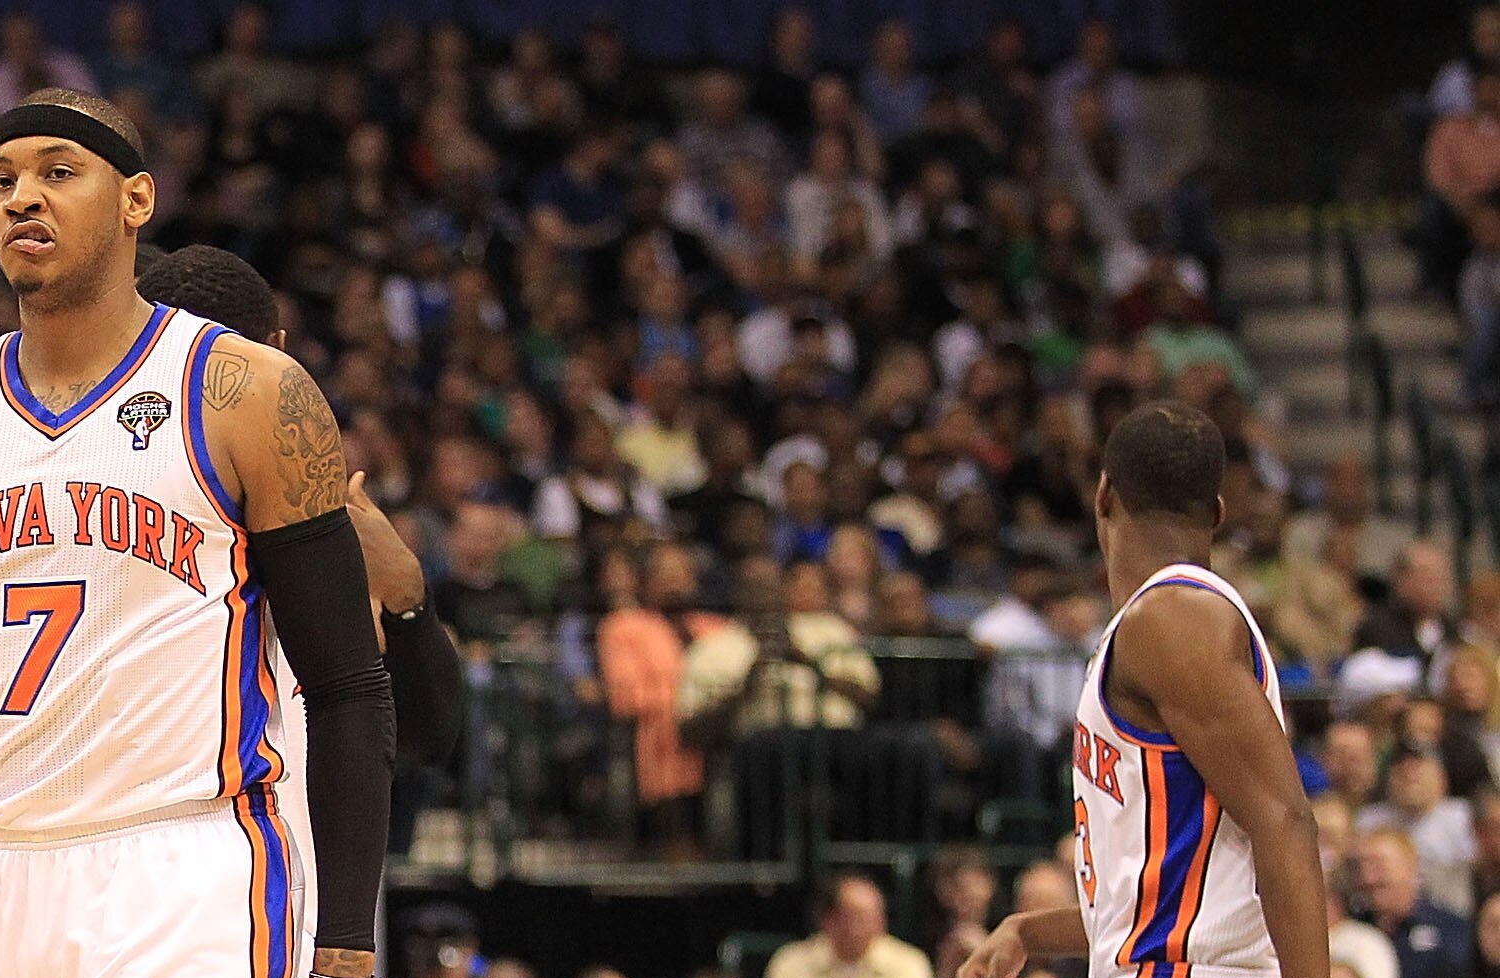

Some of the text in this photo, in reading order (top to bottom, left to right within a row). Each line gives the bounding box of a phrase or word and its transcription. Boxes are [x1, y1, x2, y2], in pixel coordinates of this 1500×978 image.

[121, 408, 168, 418] LATINA
[123, 402, 167, 413] NOCHE
[66, 481, 207, 597] YORK
